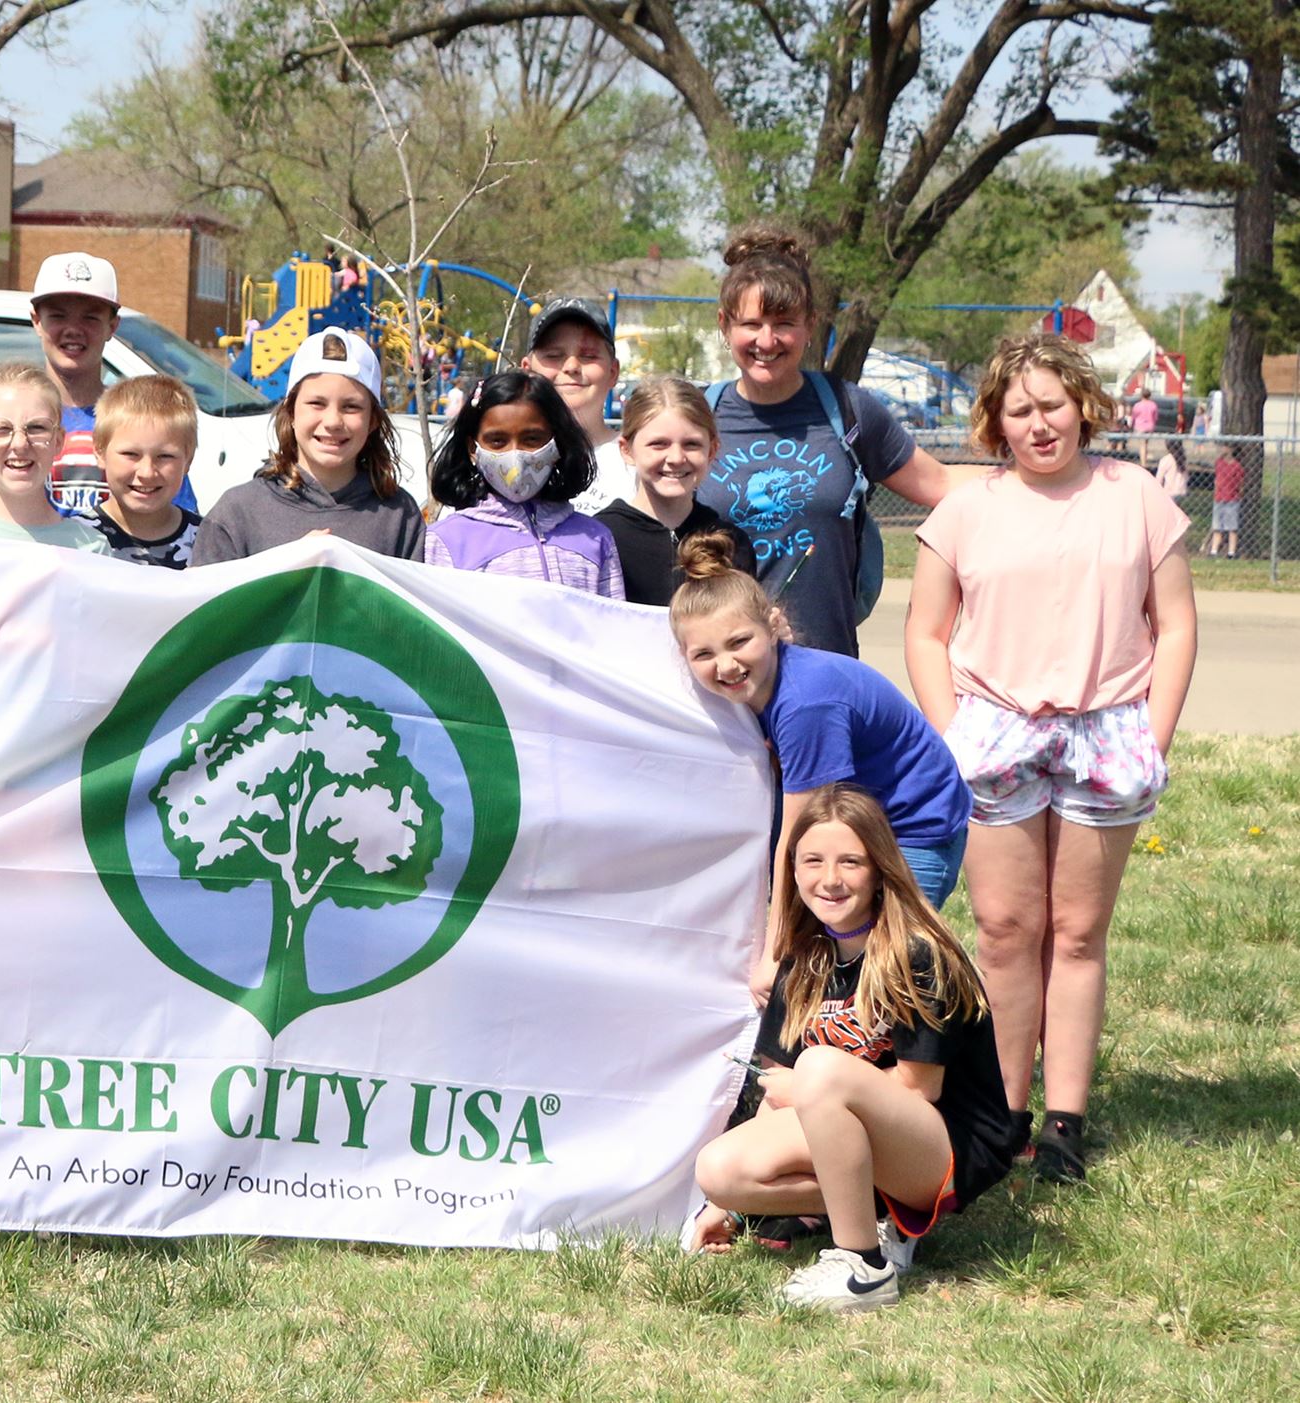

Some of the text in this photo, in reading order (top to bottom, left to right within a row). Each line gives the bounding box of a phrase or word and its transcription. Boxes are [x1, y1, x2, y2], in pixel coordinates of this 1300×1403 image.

[709, 438, 833, 483] LINCOLN
[750, 528, 814, 560] ONS
[210, 1065, 387, 1149] CITY
[8, 1155, 515, 1214] An Arbor Day Foundation Program
